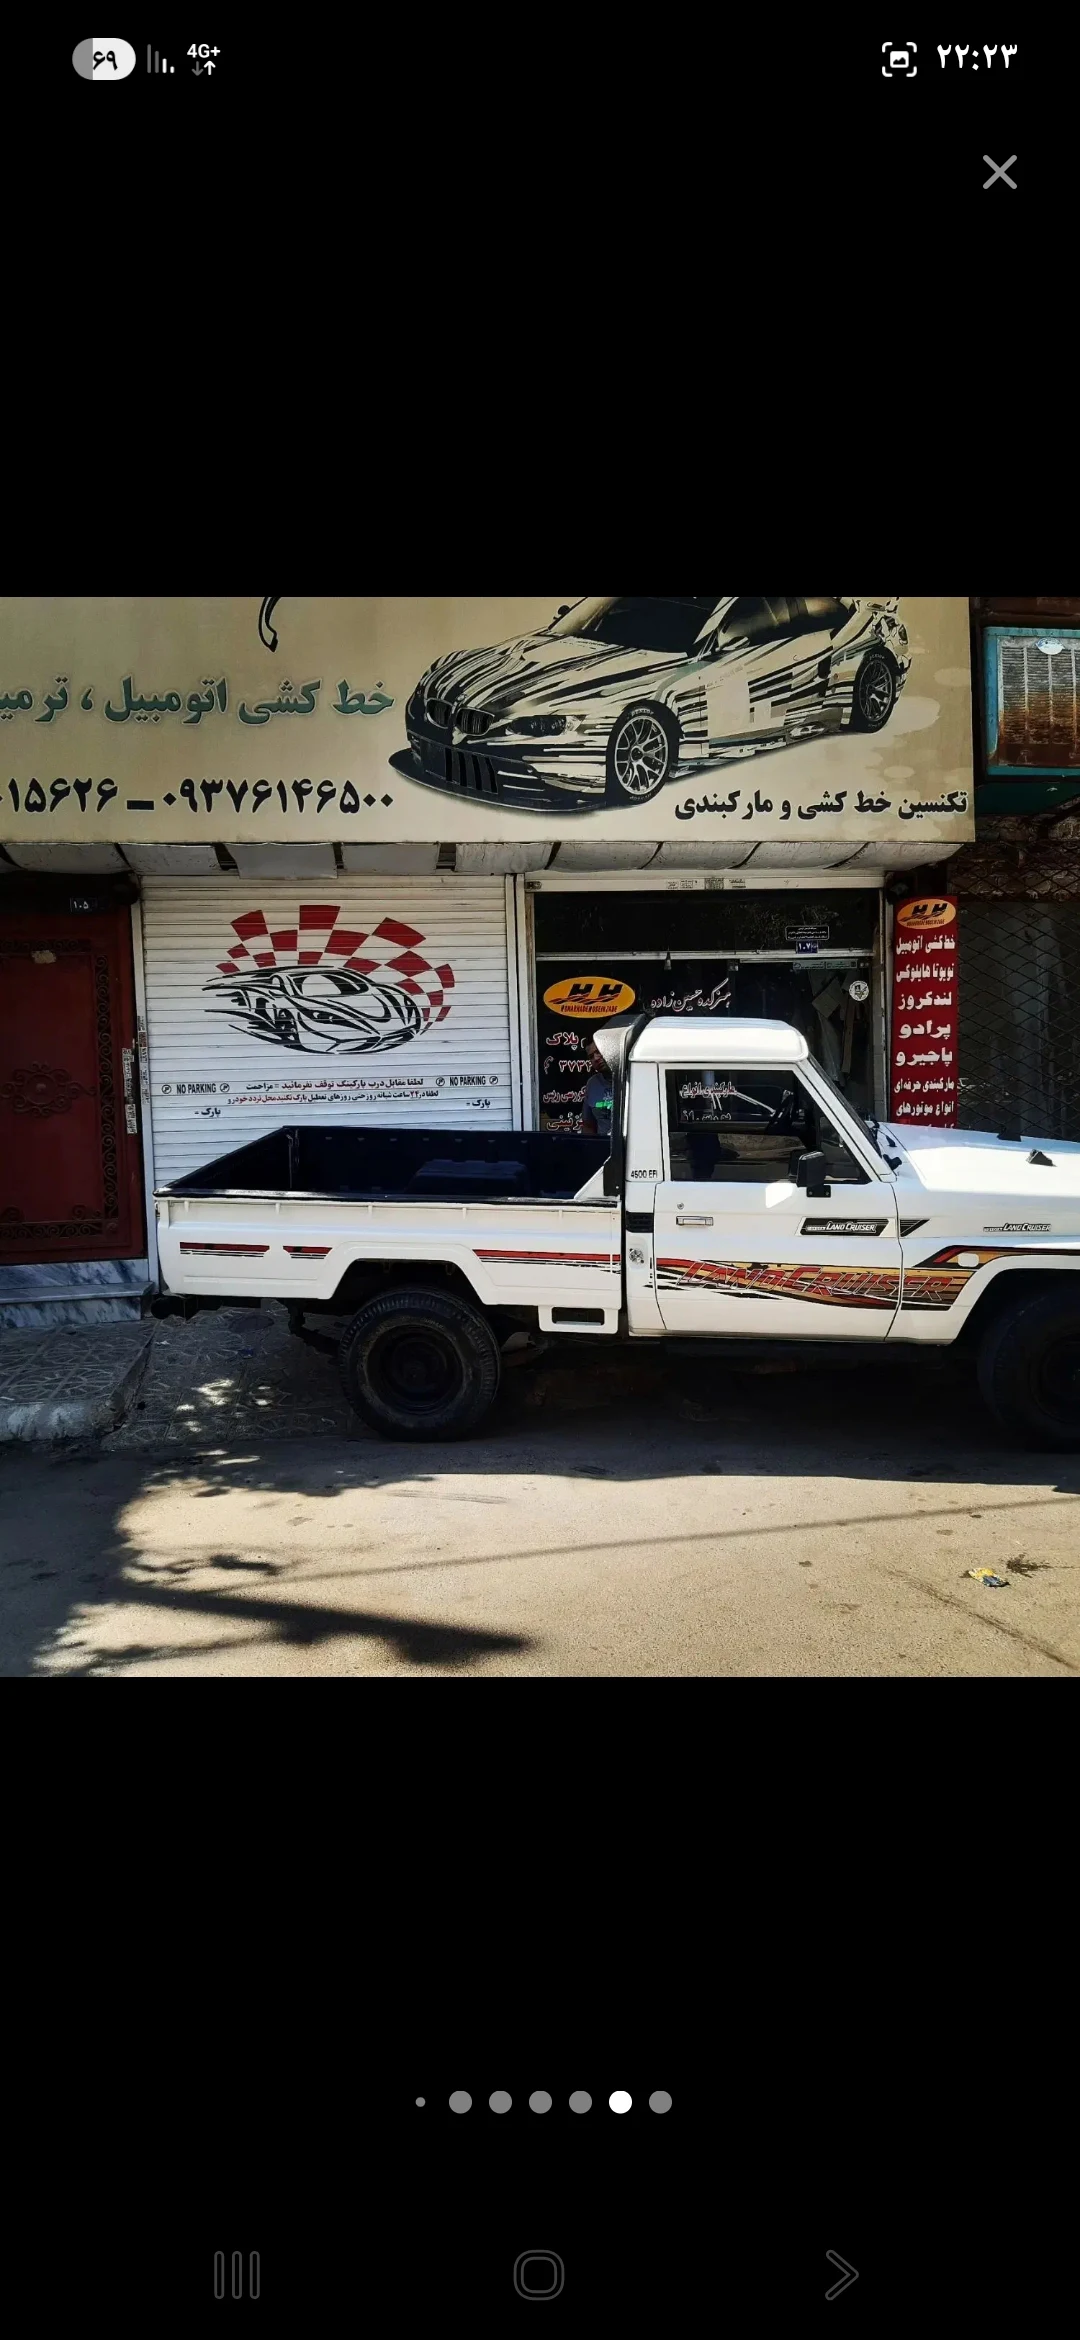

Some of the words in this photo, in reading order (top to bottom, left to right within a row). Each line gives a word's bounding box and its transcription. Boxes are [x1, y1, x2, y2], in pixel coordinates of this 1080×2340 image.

[0, 675, 69, 724] ترمی
[103, 675, 228, 726] اتومبیل
[237, 678, 322, 726] کشی
[331, 677, 395, 716] خط
[0, 777, 119, 814] ۱۵۶۲۶
[162, 777, 395, 815] ۰۹۳۷۶۱۴۶۵۰۰
[853, 789, 892, 815] خط
[778, 798, 792, 821] و
[796, 790, 848, 821] کشی
[897, 790, 969, 821] تکنسین
[73, 900, 89, 909] ۱۰۵
[798, 942, 812, 951] ۱۰۷
[896, 934, 923, 955] اتومبیل
[925, 934, 943, 954] کشی
[944, 933, 956, 950] خط
[896, 962, 931, 983] هایلوکس
[932, 962, 955, 982] تویوتا
[651, 990, 676, 1009] زاده
[898, 991, 952, 1010] لندکروز
[899, 1019, 952, 1039] پرادو
[545, 1031, 580, 1051] پلاک
[894, 1046, 953, 1067] پاجیرو
[176, 1083, 187, 1095] NO
[188, 1082, 217, 1095] PARKING
[246, 1082, 274, 1092] مزاحمت
[314, 1079, 335, 1090] توقف
[368, 1080, 385, 1089] درب
[385, 1079, 406, 1089] مقابل
[406, 1078, 424, 1086] لطفا
[450, 1077, 459, 1087] NO
[460, 1075, 486, 1087] PARKING
[307, 1093, 327, 1102] تعطیل
[327, 1093, 351, 1101] روزهای
[392, 1090, 410, 1098] ساعت
[410, 1090, 419, 1099] ۲۴
[425, 1090, 439, 1098] لطفا
[471, 1099, 491, 1108] پارک
[896, 1101, 934, 1117] موتورهای
[935, 1101, 955, 1117] انواع
[201, 1107, 222, 1118] پارک
[630, 1169, 648, 1179] 4500
[826, 1220, 846, 1231] LAND
[846, 1221, 876, 1232] CRUISER
[1003, 1222, 1022, 1231] LAND
[1022, 1222, 1052, 1232] CRUISER
